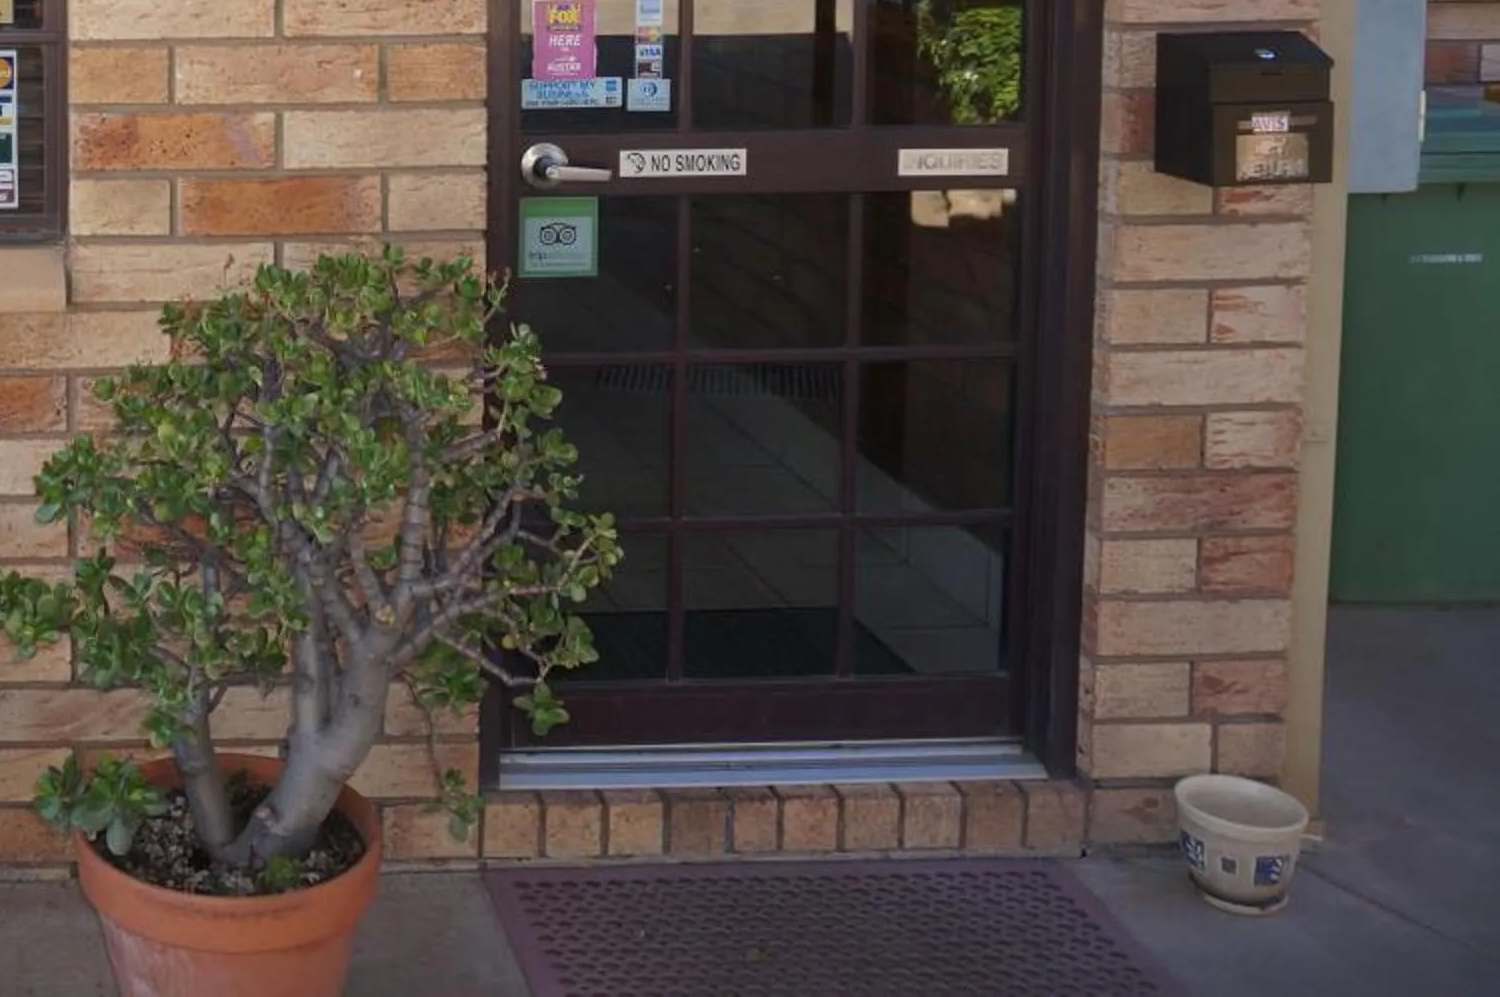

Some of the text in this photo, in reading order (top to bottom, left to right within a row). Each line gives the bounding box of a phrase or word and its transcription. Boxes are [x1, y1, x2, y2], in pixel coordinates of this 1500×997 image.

[549, 34, 582, 47] HERE
[651, 153, 741, 172] NO SMOKING
